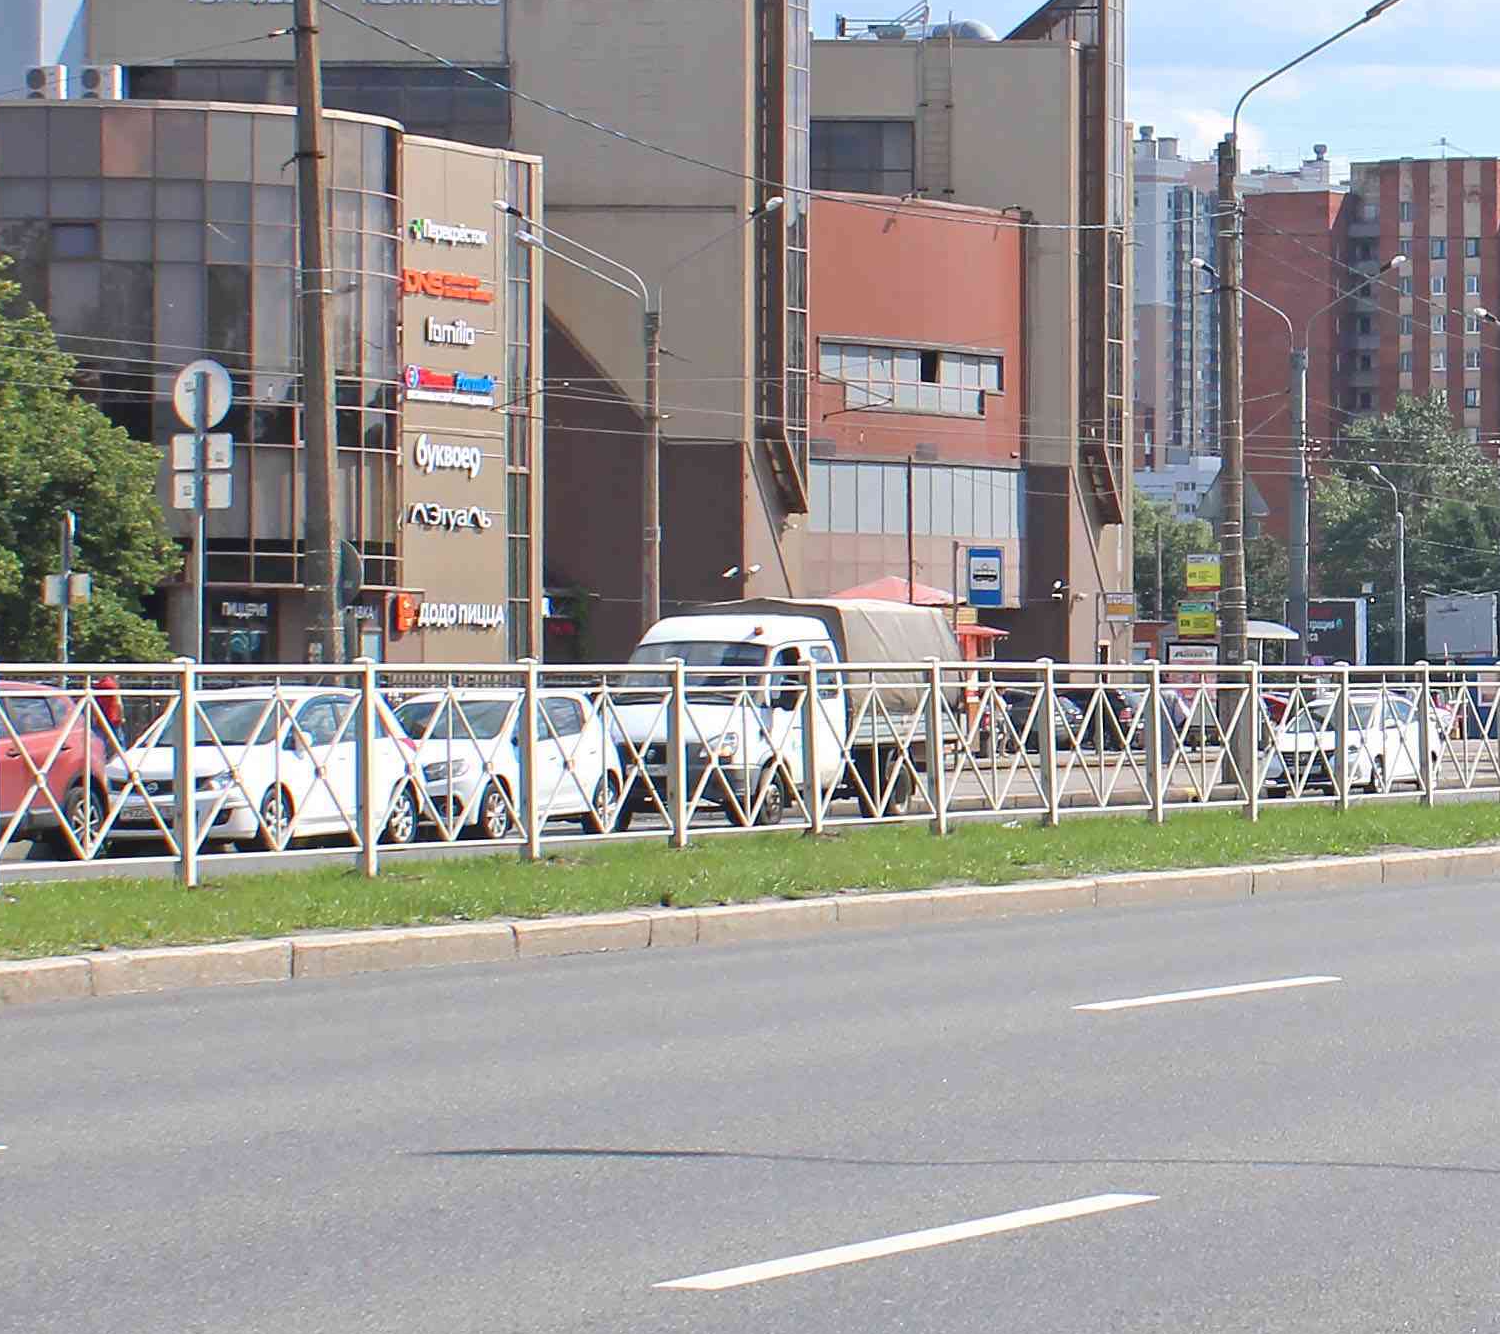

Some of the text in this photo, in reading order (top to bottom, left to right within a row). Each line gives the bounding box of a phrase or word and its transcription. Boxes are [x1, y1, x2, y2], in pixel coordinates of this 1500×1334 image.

[403, 268, 444, 298] DNS
[416, 433, 482, 478] буквоед
[418, 602, 505, 628] ДОДО ПИЦЦА
